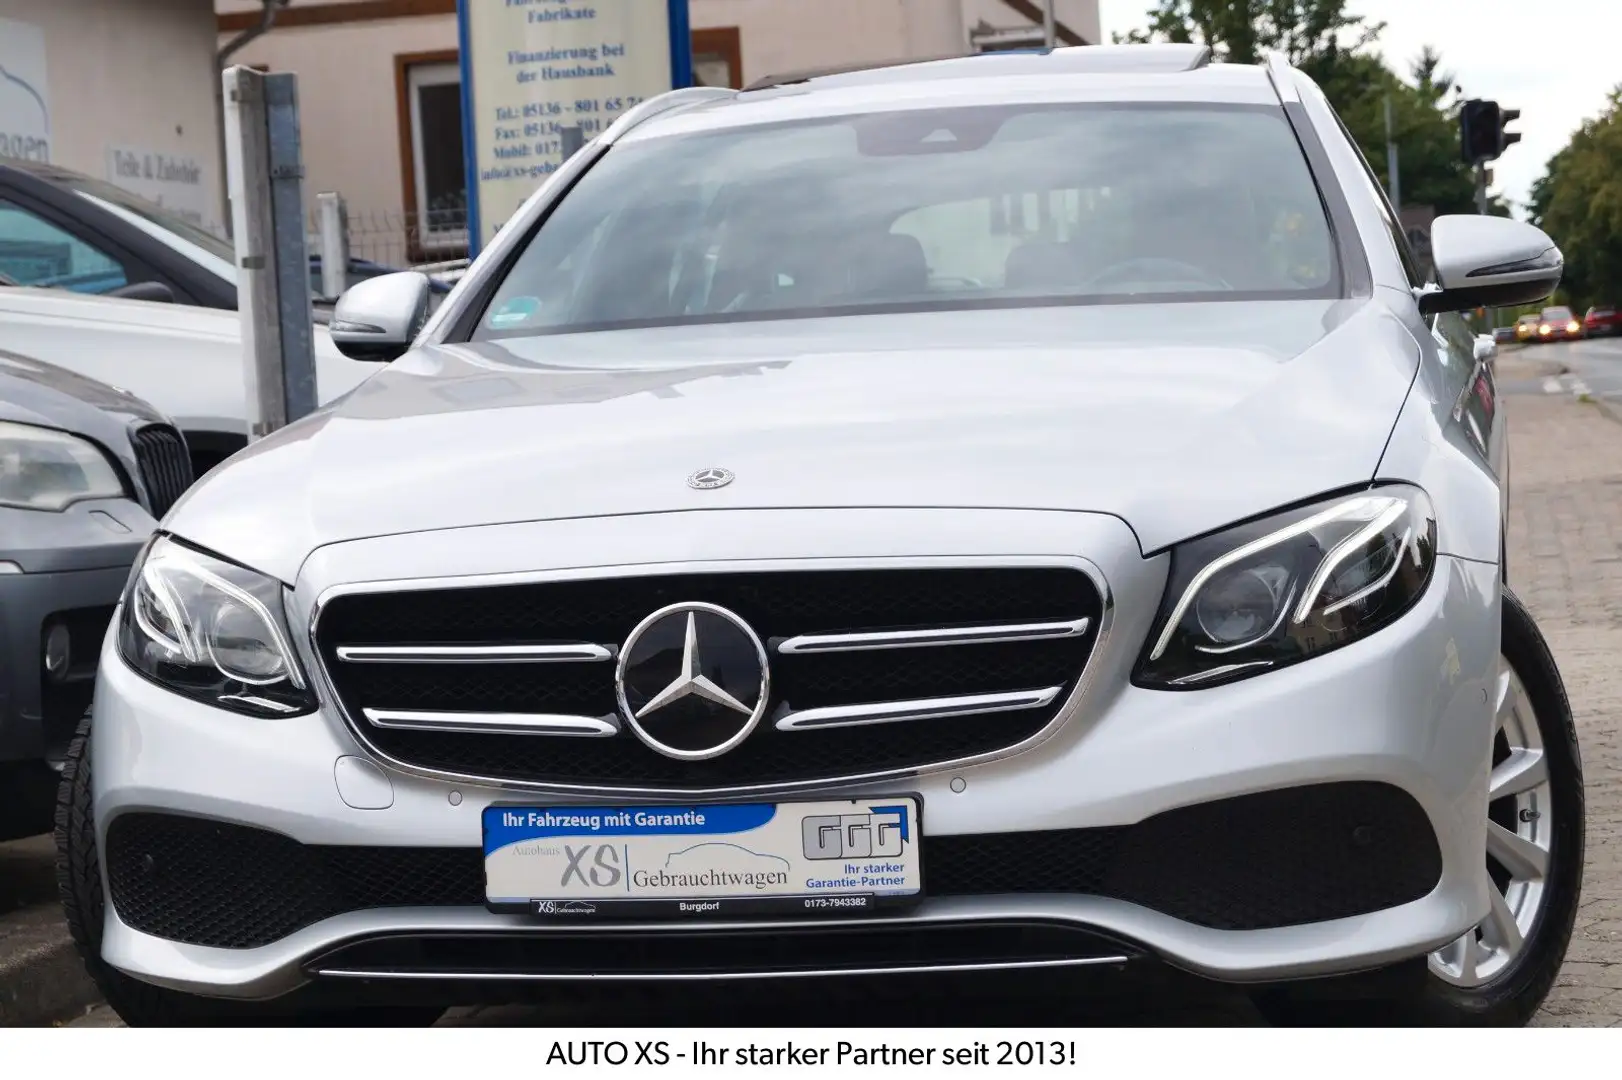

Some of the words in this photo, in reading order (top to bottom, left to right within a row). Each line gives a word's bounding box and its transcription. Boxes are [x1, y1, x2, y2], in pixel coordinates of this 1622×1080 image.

[527, 8, 597, 24] Fabrikate
[508, 46, 598, 65] Finanzierung
[602, 43, 625, 57] bei
[517, 70, 537, 83] der
[541, 64, 615, 81] Hausbank
[523, 102, 561, 117] 05136
[575, 98, 599, 113] 801
[503, 812, 525, 828] Ihr
[528, 811, 601, 831] Fahrzeug
[604, 812, 631, 827] mit
[634, 811, 706, 827] Garantie
[512, 845, 561, 857] Autohaus
[561, 844, 621, 888] XS
[633, 869, 788, 889] Gebrauchtwagen
[844, 863, 860, 875] Ihr
[864, 863, 905, 874] starker
[806, 875, 906, 889] Garantie-Partner
[538, 901, 554, 913] XS
[680, 902, 720, 912] Burgdorf
[804, 897, 866, 908] 0173-7943382
